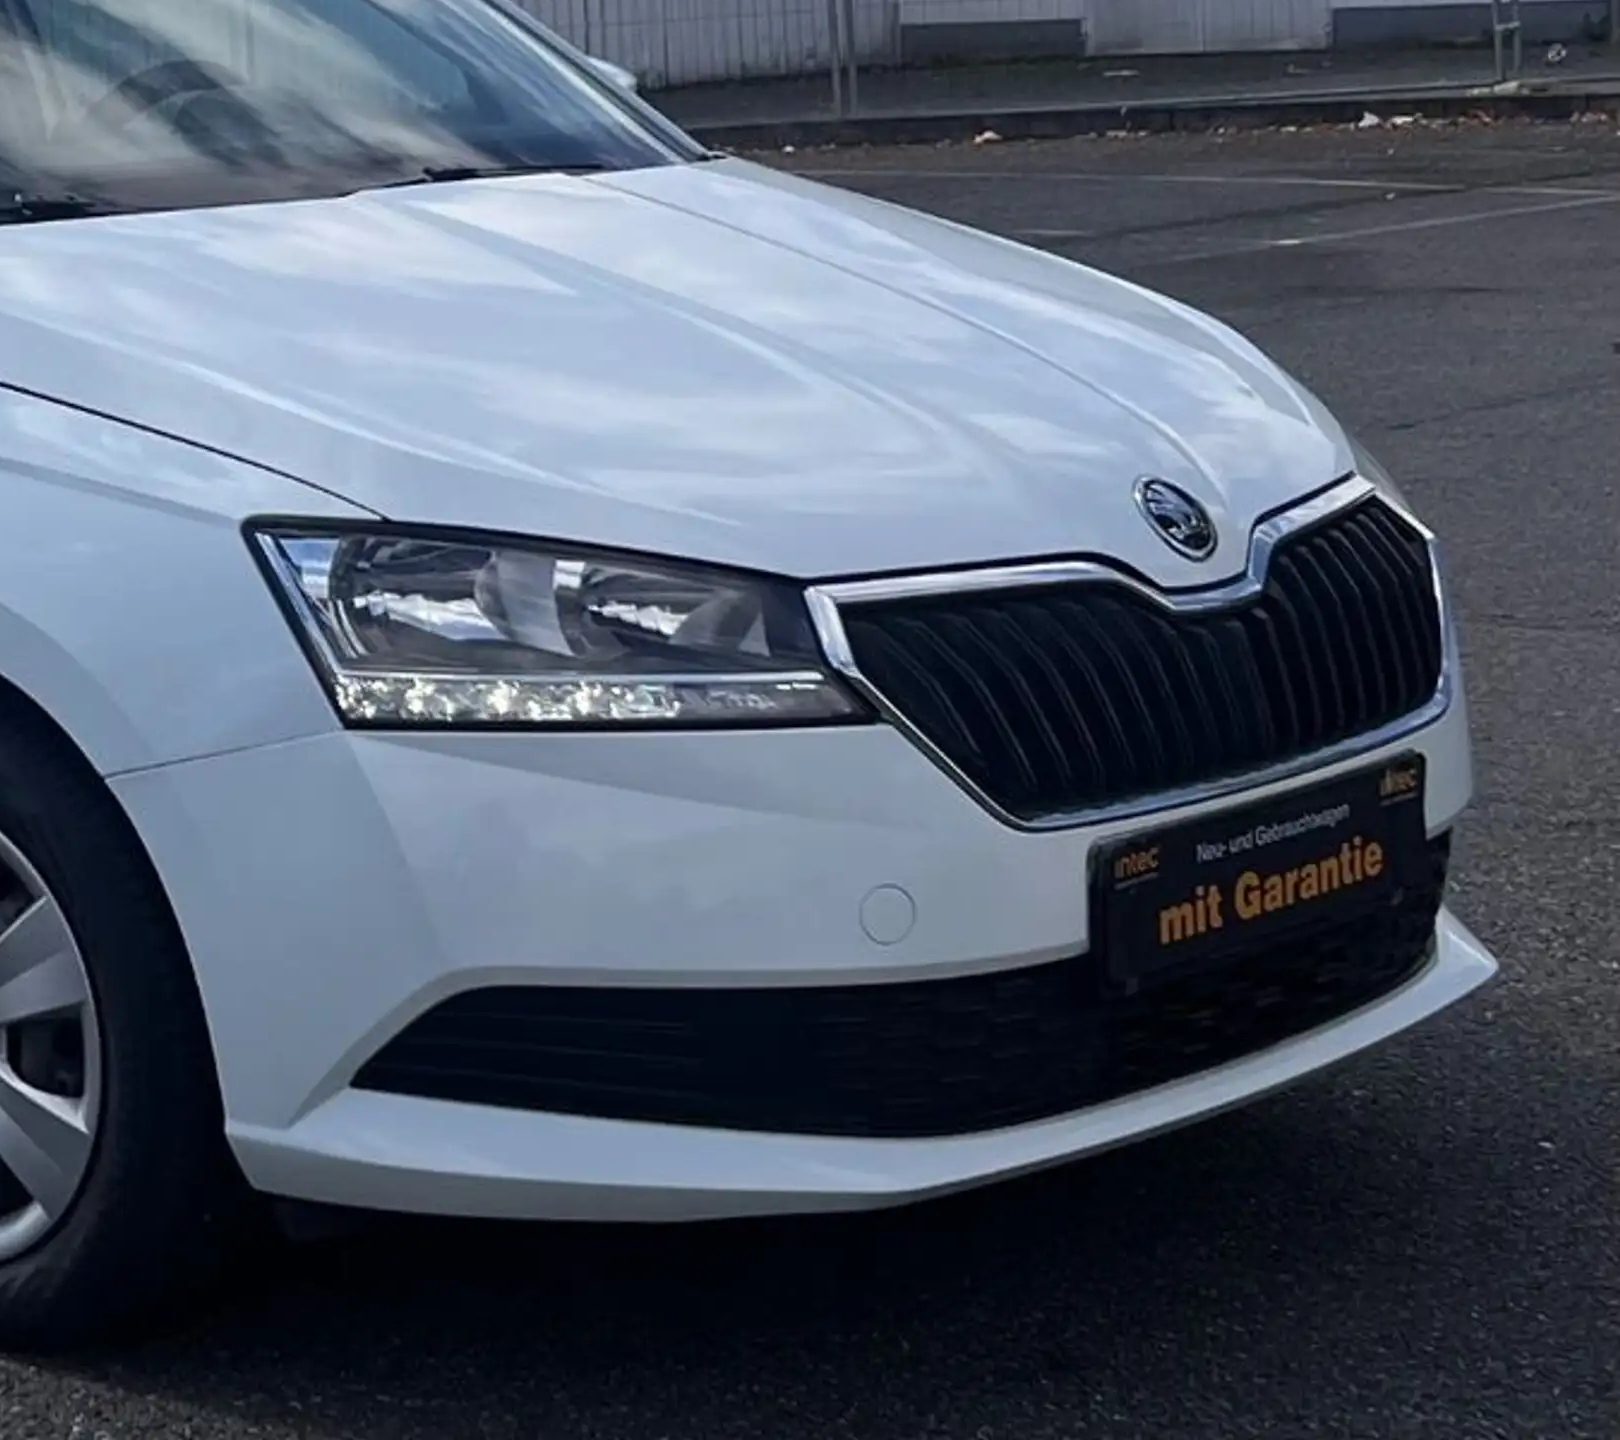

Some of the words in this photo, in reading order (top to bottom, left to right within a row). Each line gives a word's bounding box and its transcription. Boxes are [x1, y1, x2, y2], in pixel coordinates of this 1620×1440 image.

[1195, 840, 1227, 864] Neu-
[1229, 829, 1255, 854] und
[1255, 803, 1350, 847] Gebrauchtwagen
[1159, 883, 1223, 945] mit
[1234, 834, 1384, 921] Garantie
